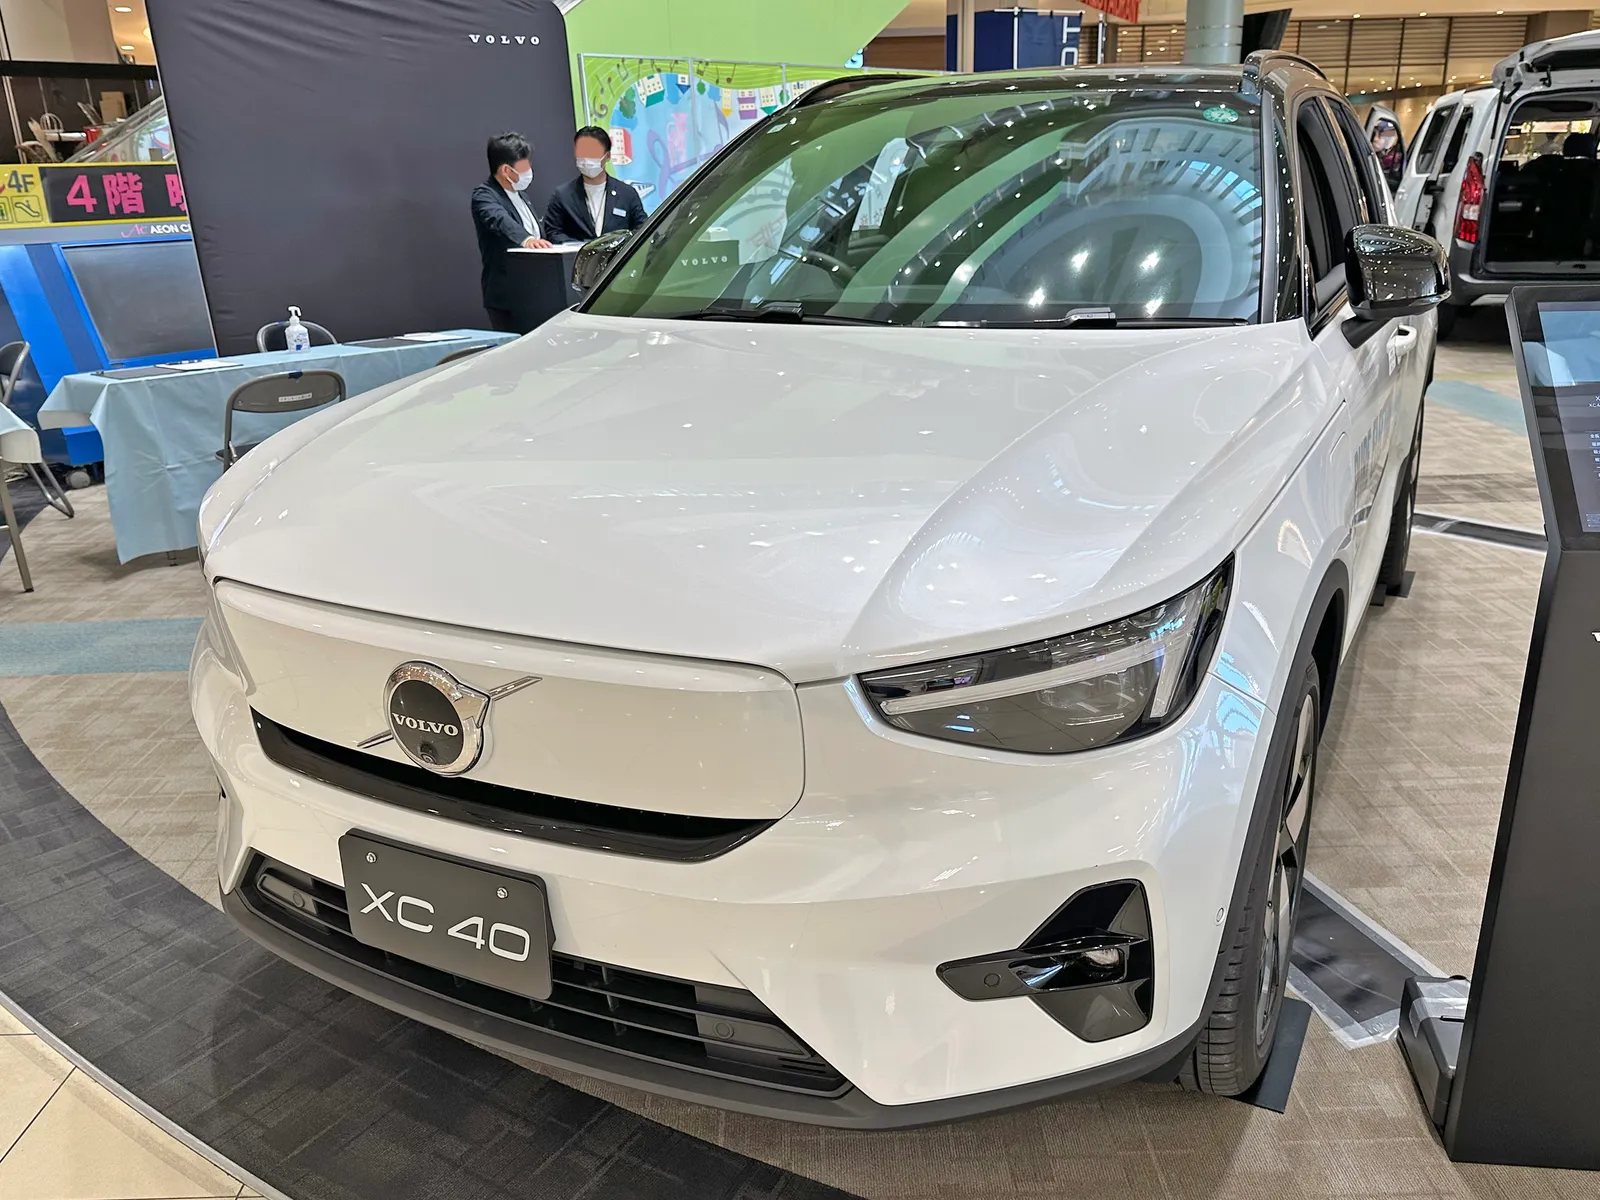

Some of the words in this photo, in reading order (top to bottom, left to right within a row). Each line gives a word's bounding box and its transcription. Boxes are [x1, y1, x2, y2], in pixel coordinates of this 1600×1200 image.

[468, 34, 540, 45] VOLVO
[7, 170, 35, 193] 4F
[150, 225, 180, 234] AEON
[681, 255, 728, 266] VOLVO
[391, 712, 459, 736] VOLVO
[360, 882, 435, 933] XC
[447, 916, 531, 962] 40
